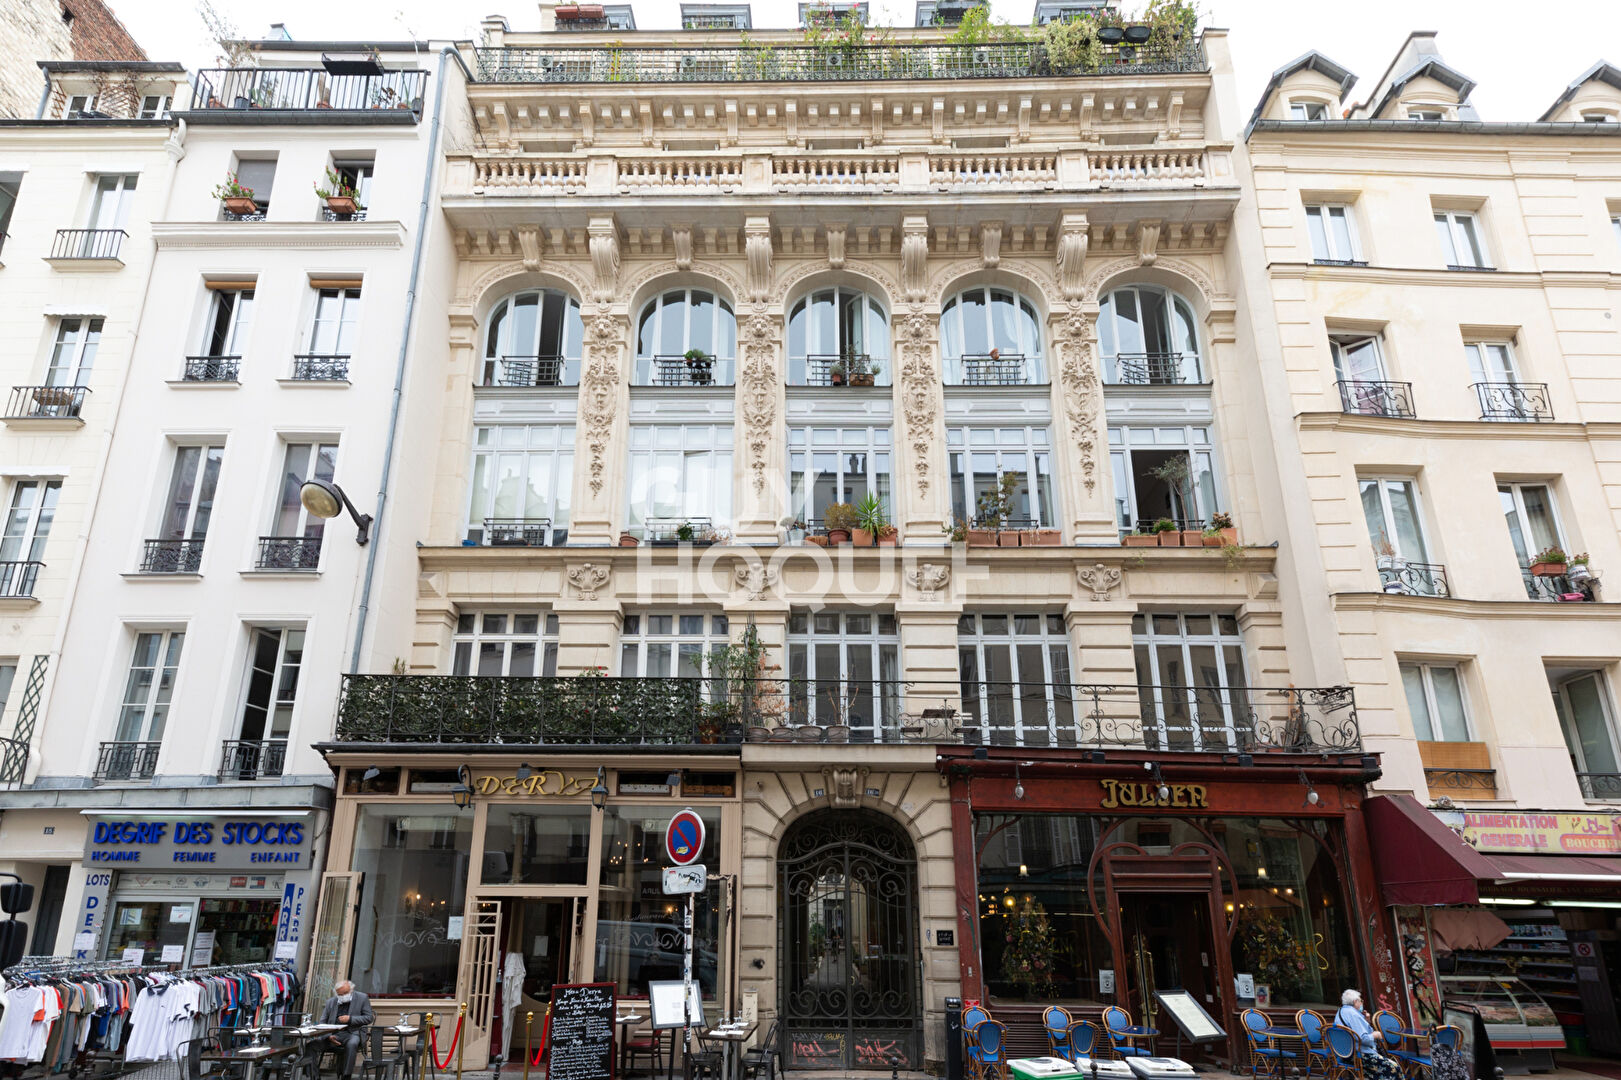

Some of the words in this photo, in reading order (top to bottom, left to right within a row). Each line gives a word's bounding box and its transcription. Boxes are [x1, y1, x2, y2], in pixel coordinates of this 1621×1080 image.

[474, 769, 599, 797] DERYA
[1100, 778, 1209, 809] JULIEN
[1464, 814, 1558, 829] ALIMENTATION
[93, 821, 168, 844] DEGRIF
[173, 821, 214, 845] DES
[222, 822, 304, 845] STOCKS
[1480, 832, 1549, 848] GENERALE
[91, 850, 141, 863] HOMME
[173, 851, 216, 863] FEMME
[250, 851, 300, 863] ENFANT
[85, 873, 110, 886] LOTS
